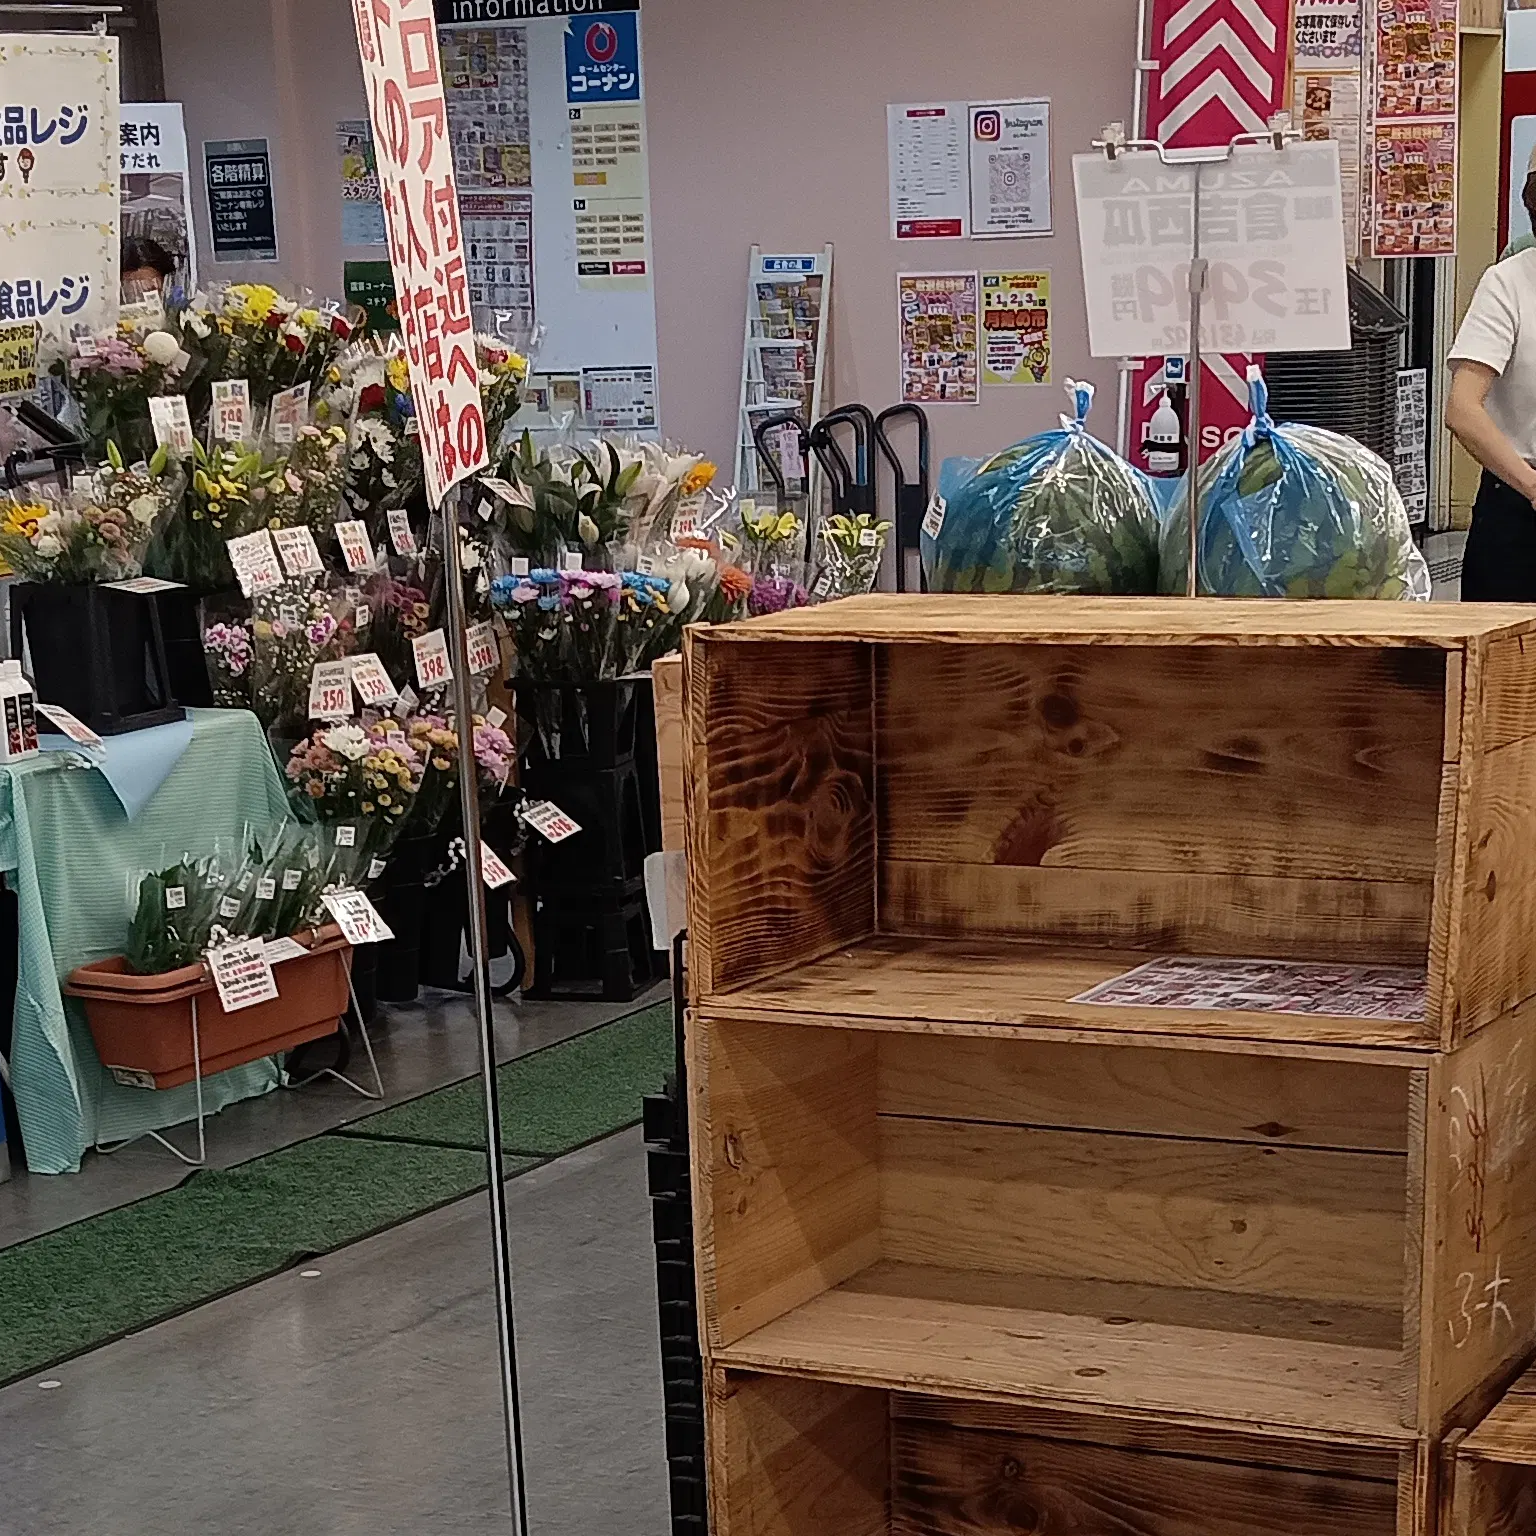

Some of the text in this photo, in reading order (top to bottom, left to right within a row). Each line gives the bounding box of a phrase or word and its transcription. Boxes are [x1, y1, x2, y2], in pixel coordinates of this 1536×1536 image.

[570, 72, 636, 93] コーナン
[1004, 117, 1044, 131] Instagram
[211, 162, 266, 184] 各階精算
[398, 0, 485, 469] ロア付近への
[421, 655, 446, 683] 398
[321, 687, 346, 712] 350
